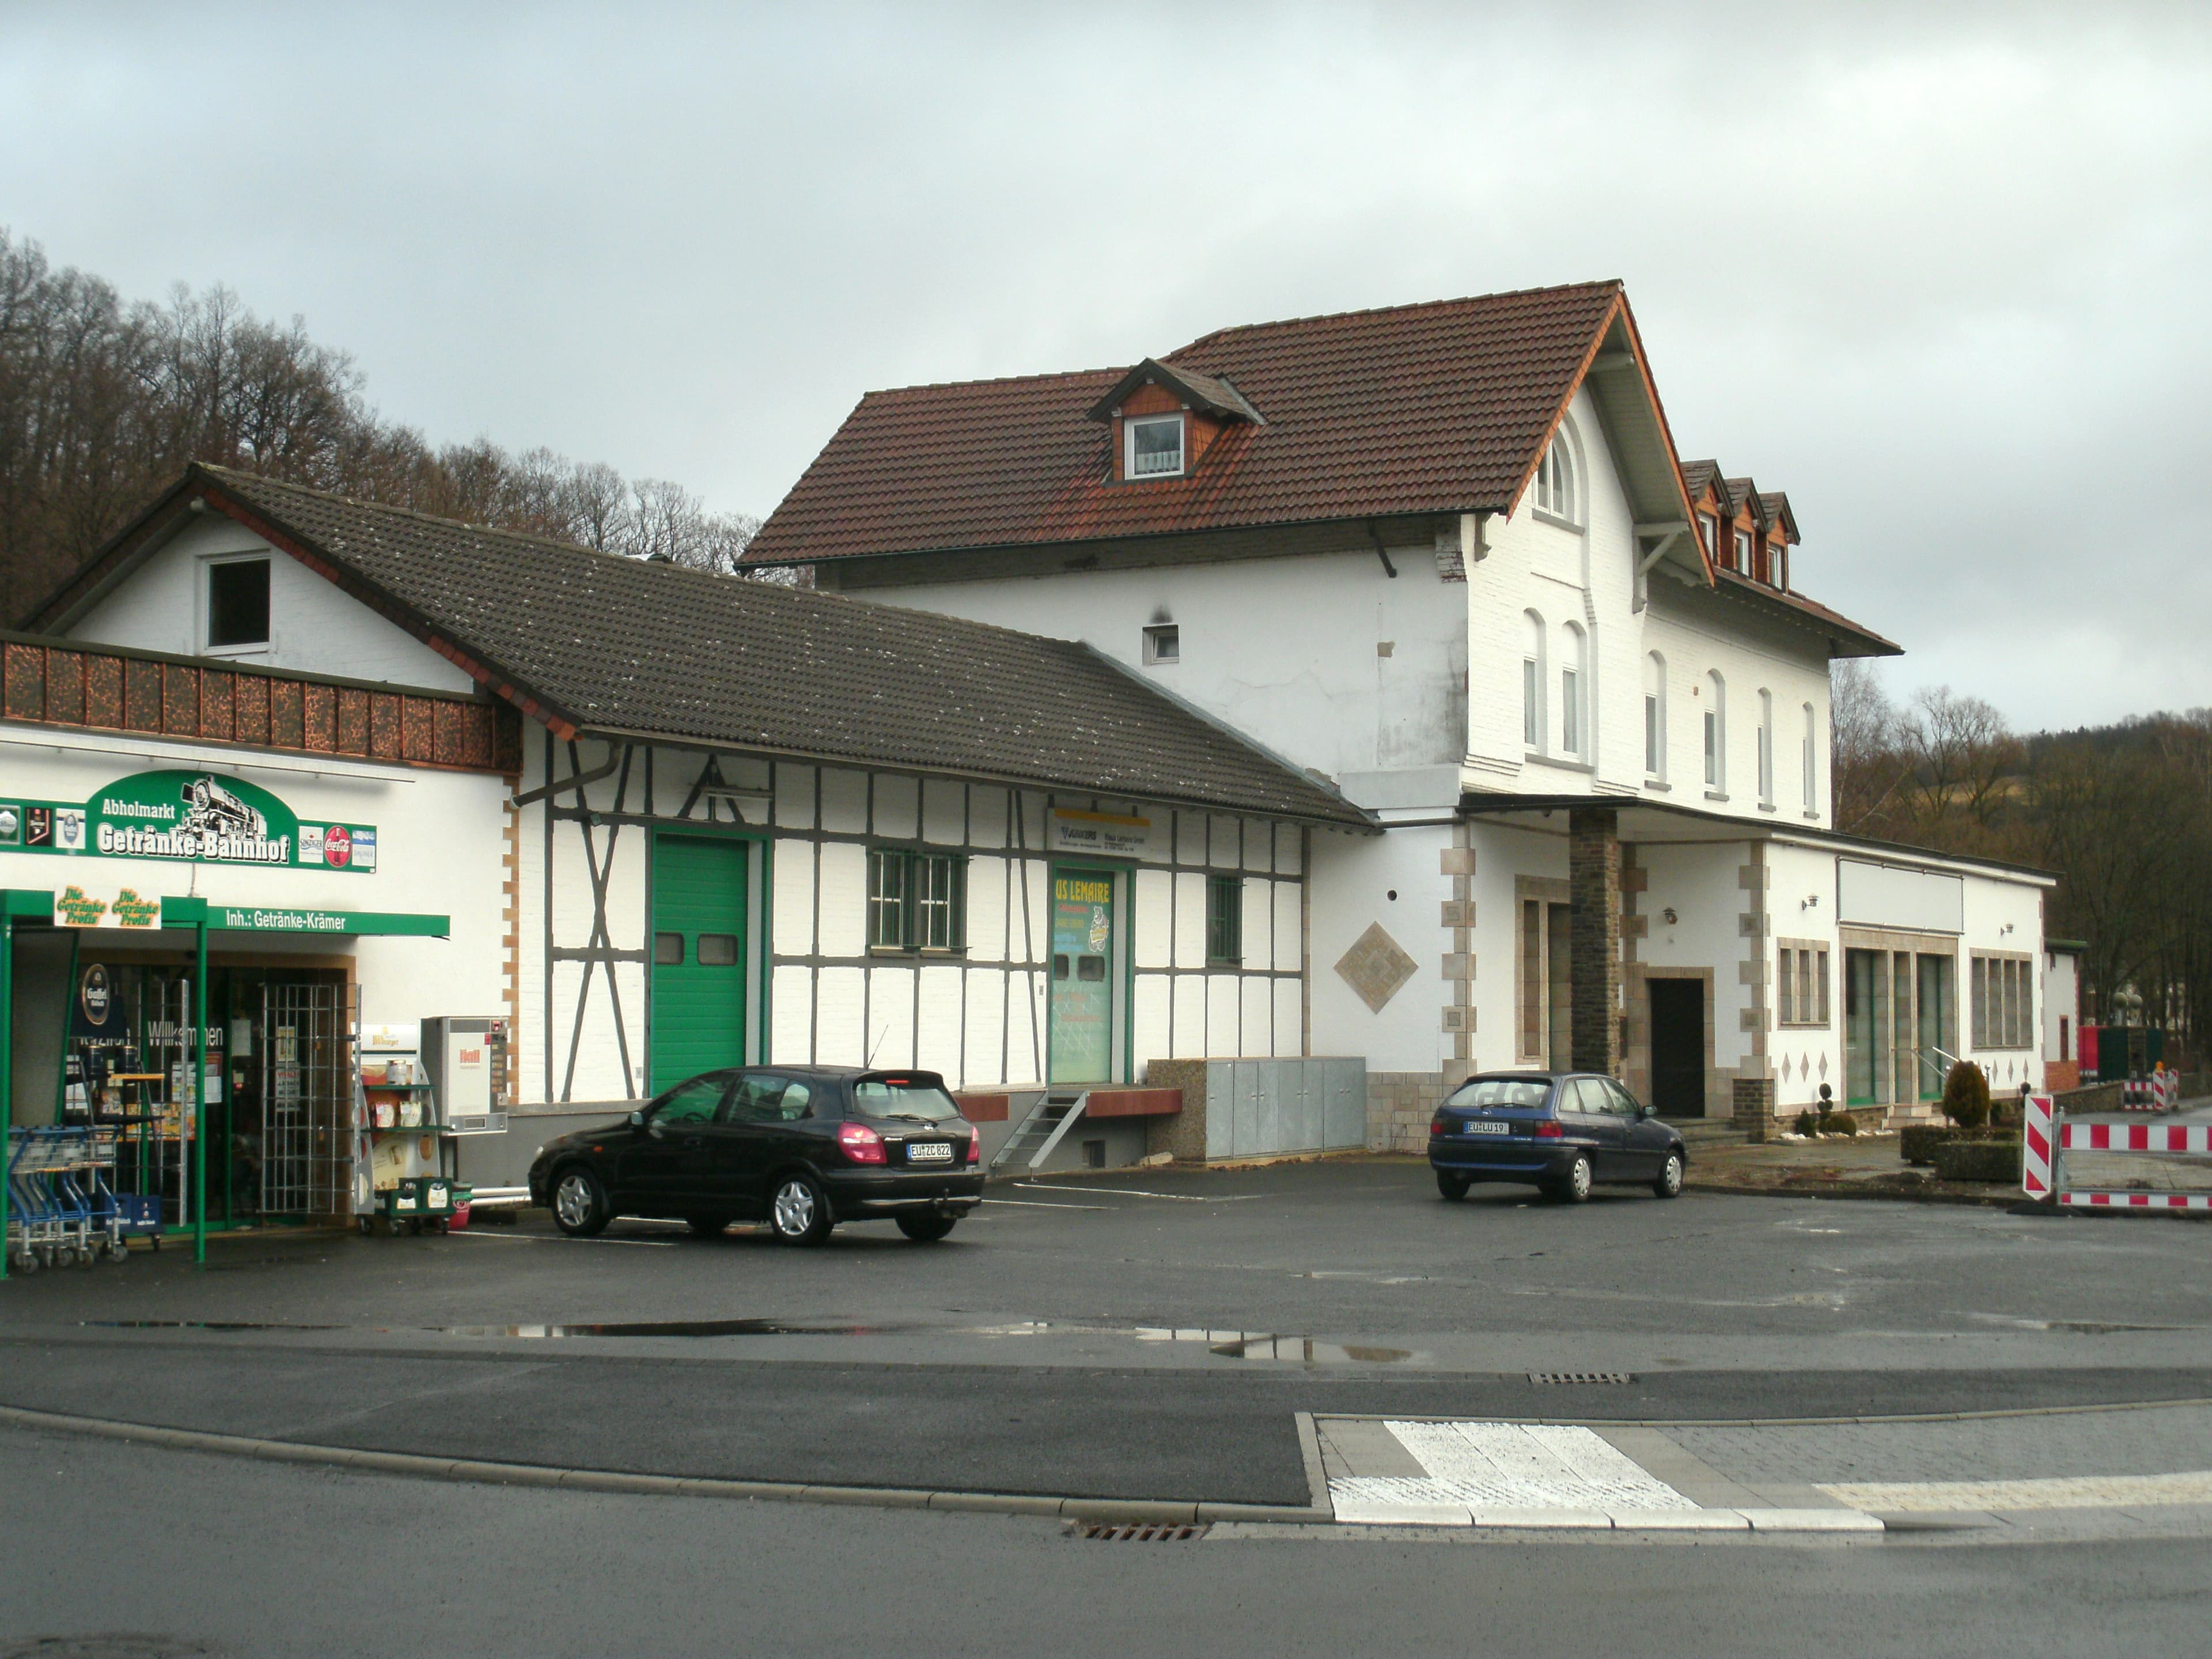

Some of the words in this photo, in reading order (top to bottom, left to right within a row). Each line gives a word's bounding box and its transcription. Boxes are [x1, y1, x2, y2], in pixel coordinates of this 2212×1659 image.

[102, 798, 175, 819] Abholmarkt
[97, 823, 290, 863] Getränke-Bahnhof
[65, 888, 82, 900] Die
[119, 891, 137, 903] Die
[1055, 879, 1068, 900] US
[1070, 881, 1110, 903] LEMAIRE
[56, 899, 107, 914] Getränke
[112, 902, 159, 915] Getränke
[66, 912, 97, 924] Profis
[120, 914, 151, 926] Profis
[226, 909, 252, 927] Inh.:
[254, 910, 346, 930] Getränke-Krämer
[1468, 1123, 1478, 1131] EU
[1483, 1123, 1493, 1132] LU
[1494, 1124, 1504, 1132] 19
[911, 1145, 922, 1157] EU
[926, 1145, 936, 1156] ZC
[937, 1145, 950, 1156] 822
